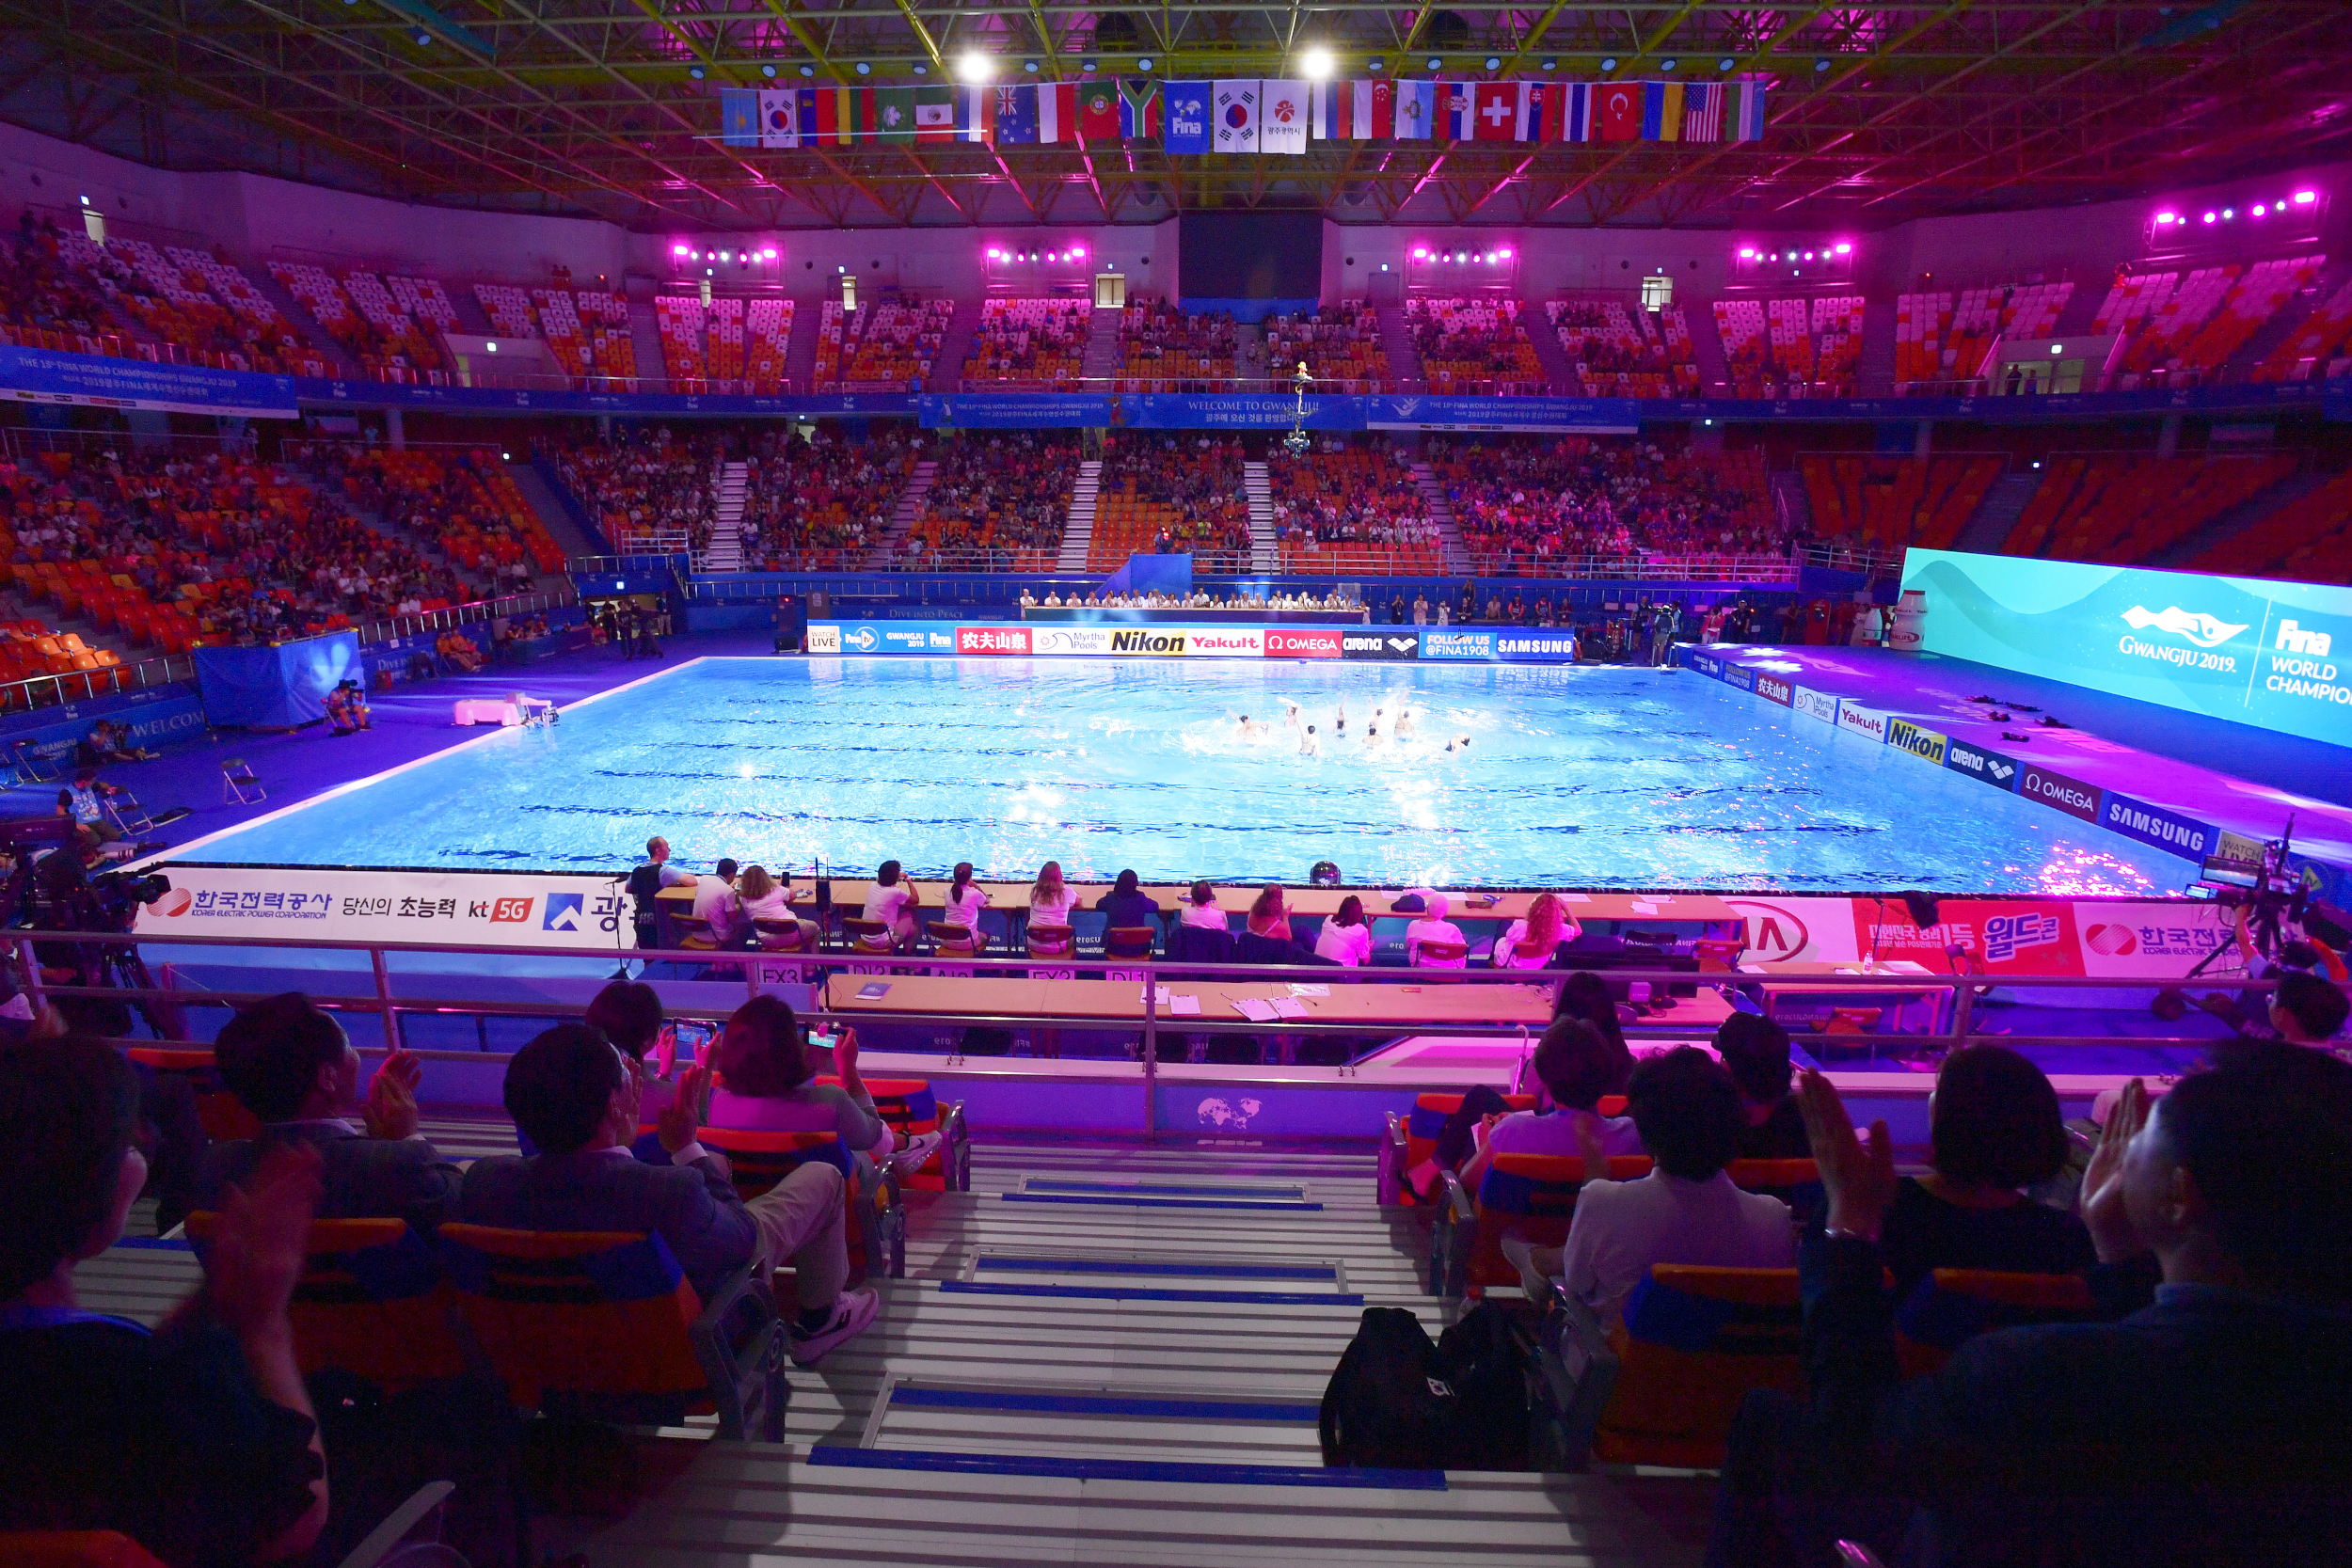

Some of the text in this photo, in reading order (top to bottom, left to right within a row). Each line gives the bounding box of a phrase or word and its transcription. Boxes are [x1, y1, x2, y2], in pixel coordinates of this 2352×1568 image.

[1172, 118, 1202, 135] Fina
[1267, 126, 1301, 136] 광주광역시
[19, 356, 39, 368] THE
[79, 364, 111, 375] WORLD
[112, 367, 180, 383] CHAMPIONSHIPS
[218, 377, 237, 388] 2019
[1188, 402, 1241, 411] WELCOME
[1244, 402, 1259, 411] TO
[1492, 403, 1545, 411] CHAMPIONSHIPS
[1205, 414, 1229, 422] 광주에
[1230, 414, 1246, 422] 오신
[1248, 414, 1263, 422] 것을
[889, 609, 914, 619] DIVE
[937, 610, 964, 619] PEACE
[812, 638, 835, 647] LIVE
[885, 632, 925, 641] GWANGJU
[908, 640, 925, 648] 2019
[930, 633, 952, 645] Fina
[961, 631, 1027, 650] 农夫山泉
[1073, 633, 1105, 643] Myrtha
[1111, 631, 1185, 652] Nikon
[1191, 637, 1260, 649] Yakult
[1286, 639, 1338, 650] OMEGA
[1343, 637, 1382, 651] arena
[1427, 634, 1489, 645] FOLLOW US
[2274, 618, 2332, 657] Fina
[1073, 641, 1098, 650] Pools
[1425, 645, 1489, 656] @FINA1908
[1497, 639, 1572, 654] SAMSUNG
[2119, 635, 2236, 673] GWANGJU 2019
[2271, 656, 2337, 681] WORLD
[1724, 672, 1750, 689] @FINA1908
[1757, 677, 1789, 703] 农夫山泉
[2265, 674, 2352, 705] CHAMPIO
[1815, 695, 1835, 710] Myrtha
[1814, 705, 1829, 719] Pools
[1841, 708, 1883, 734] Yakult
[33, 737, 78, 755] GWANGJU
[1889, 722, 1944, 761] Nikon
[1950, 747, 1984, 772] arena
[2042, 782, 2094, 813] OMEGA
[2109, 803, 2204, 851] SAMSUNG
[2223, 839, 2261, 860] WATCH
[195, 889, 333, 911] 한국전력공사
[342, 895, 456, 920] 당신의 초능력
[216, 910, 246, 918] ELECTRIC
[246, 911, 274, 919] POWER
[275, 911, 327, 920] CORPORATION
[469, 899, 525, 920] kt 5G
[591, 896, 636, 932] 광
[1868, 924, 1915, 941] 대한민국
[1982, 912, 2060, 961] 월드콘
[1871, 940, 1893, 948] 218년
